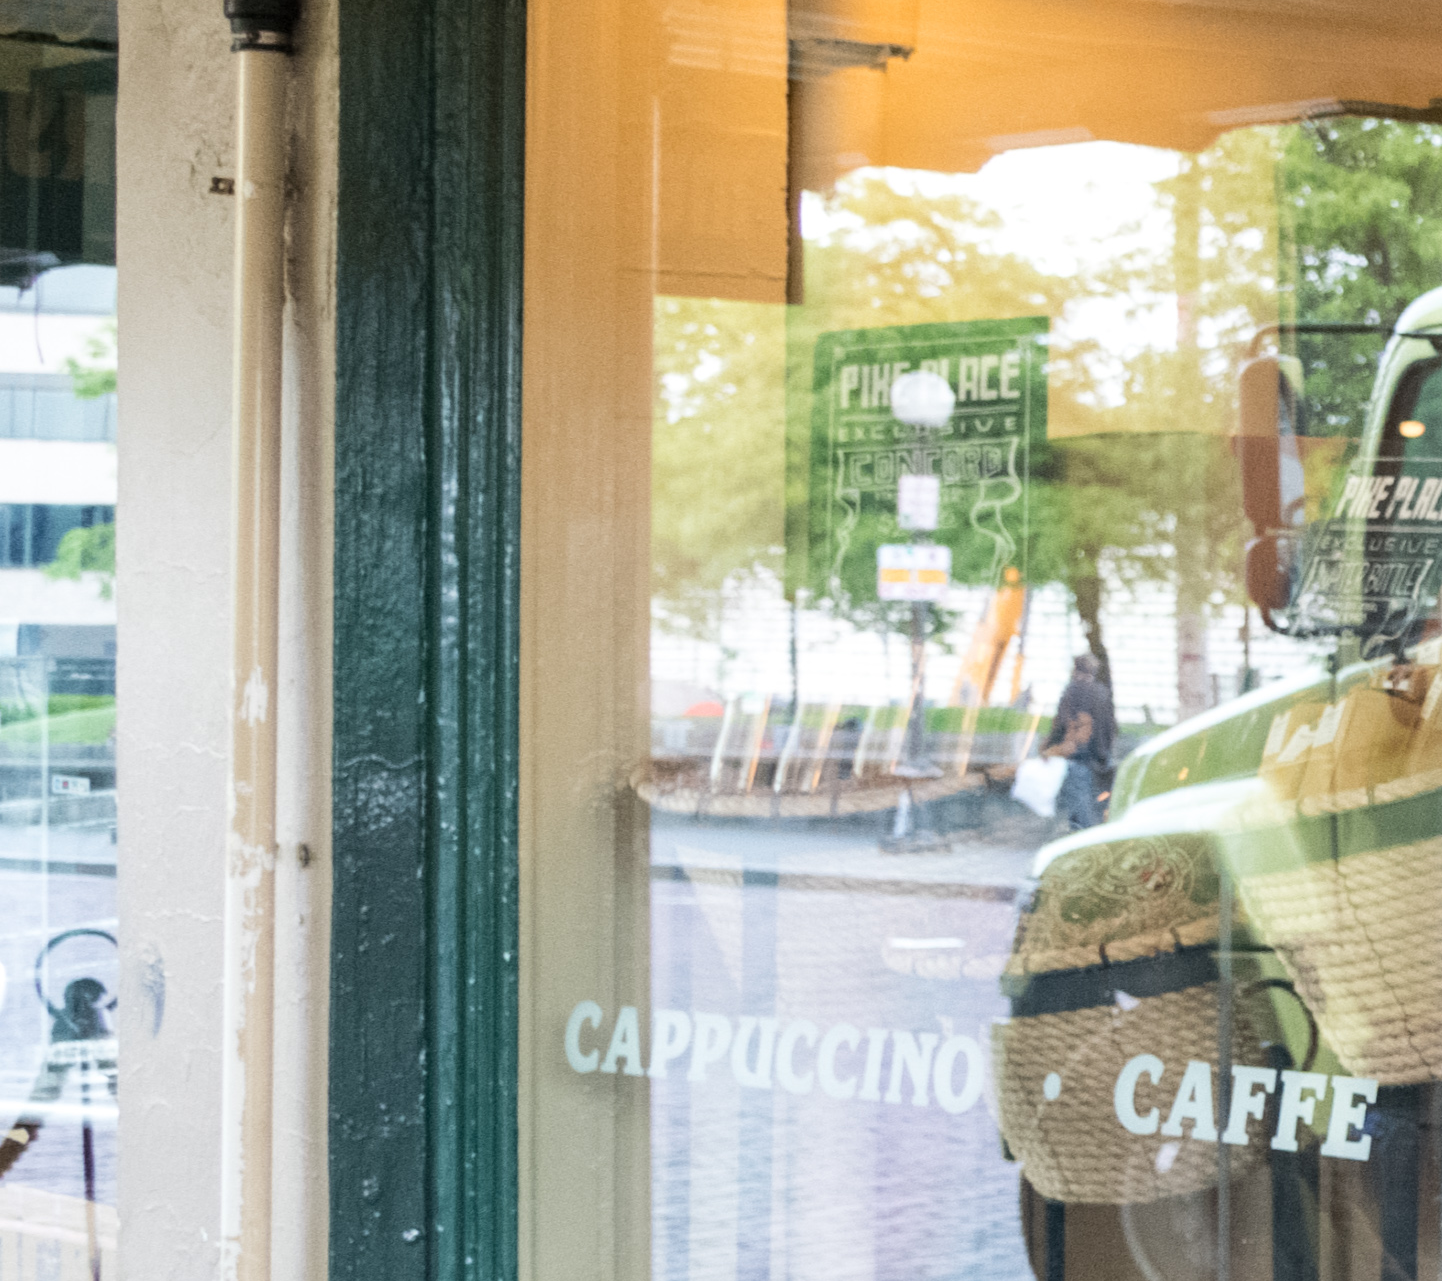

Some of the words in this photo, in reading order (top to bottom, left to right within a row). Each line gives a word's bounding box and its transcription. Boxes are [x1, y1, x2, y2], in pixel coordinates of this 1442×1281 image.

[1335, 475, 1395, 519] PIKE
[564, 1000, 983, 1115] CAPPUCCINO
[1113, 1053, 1379, 1160] CAFFE
